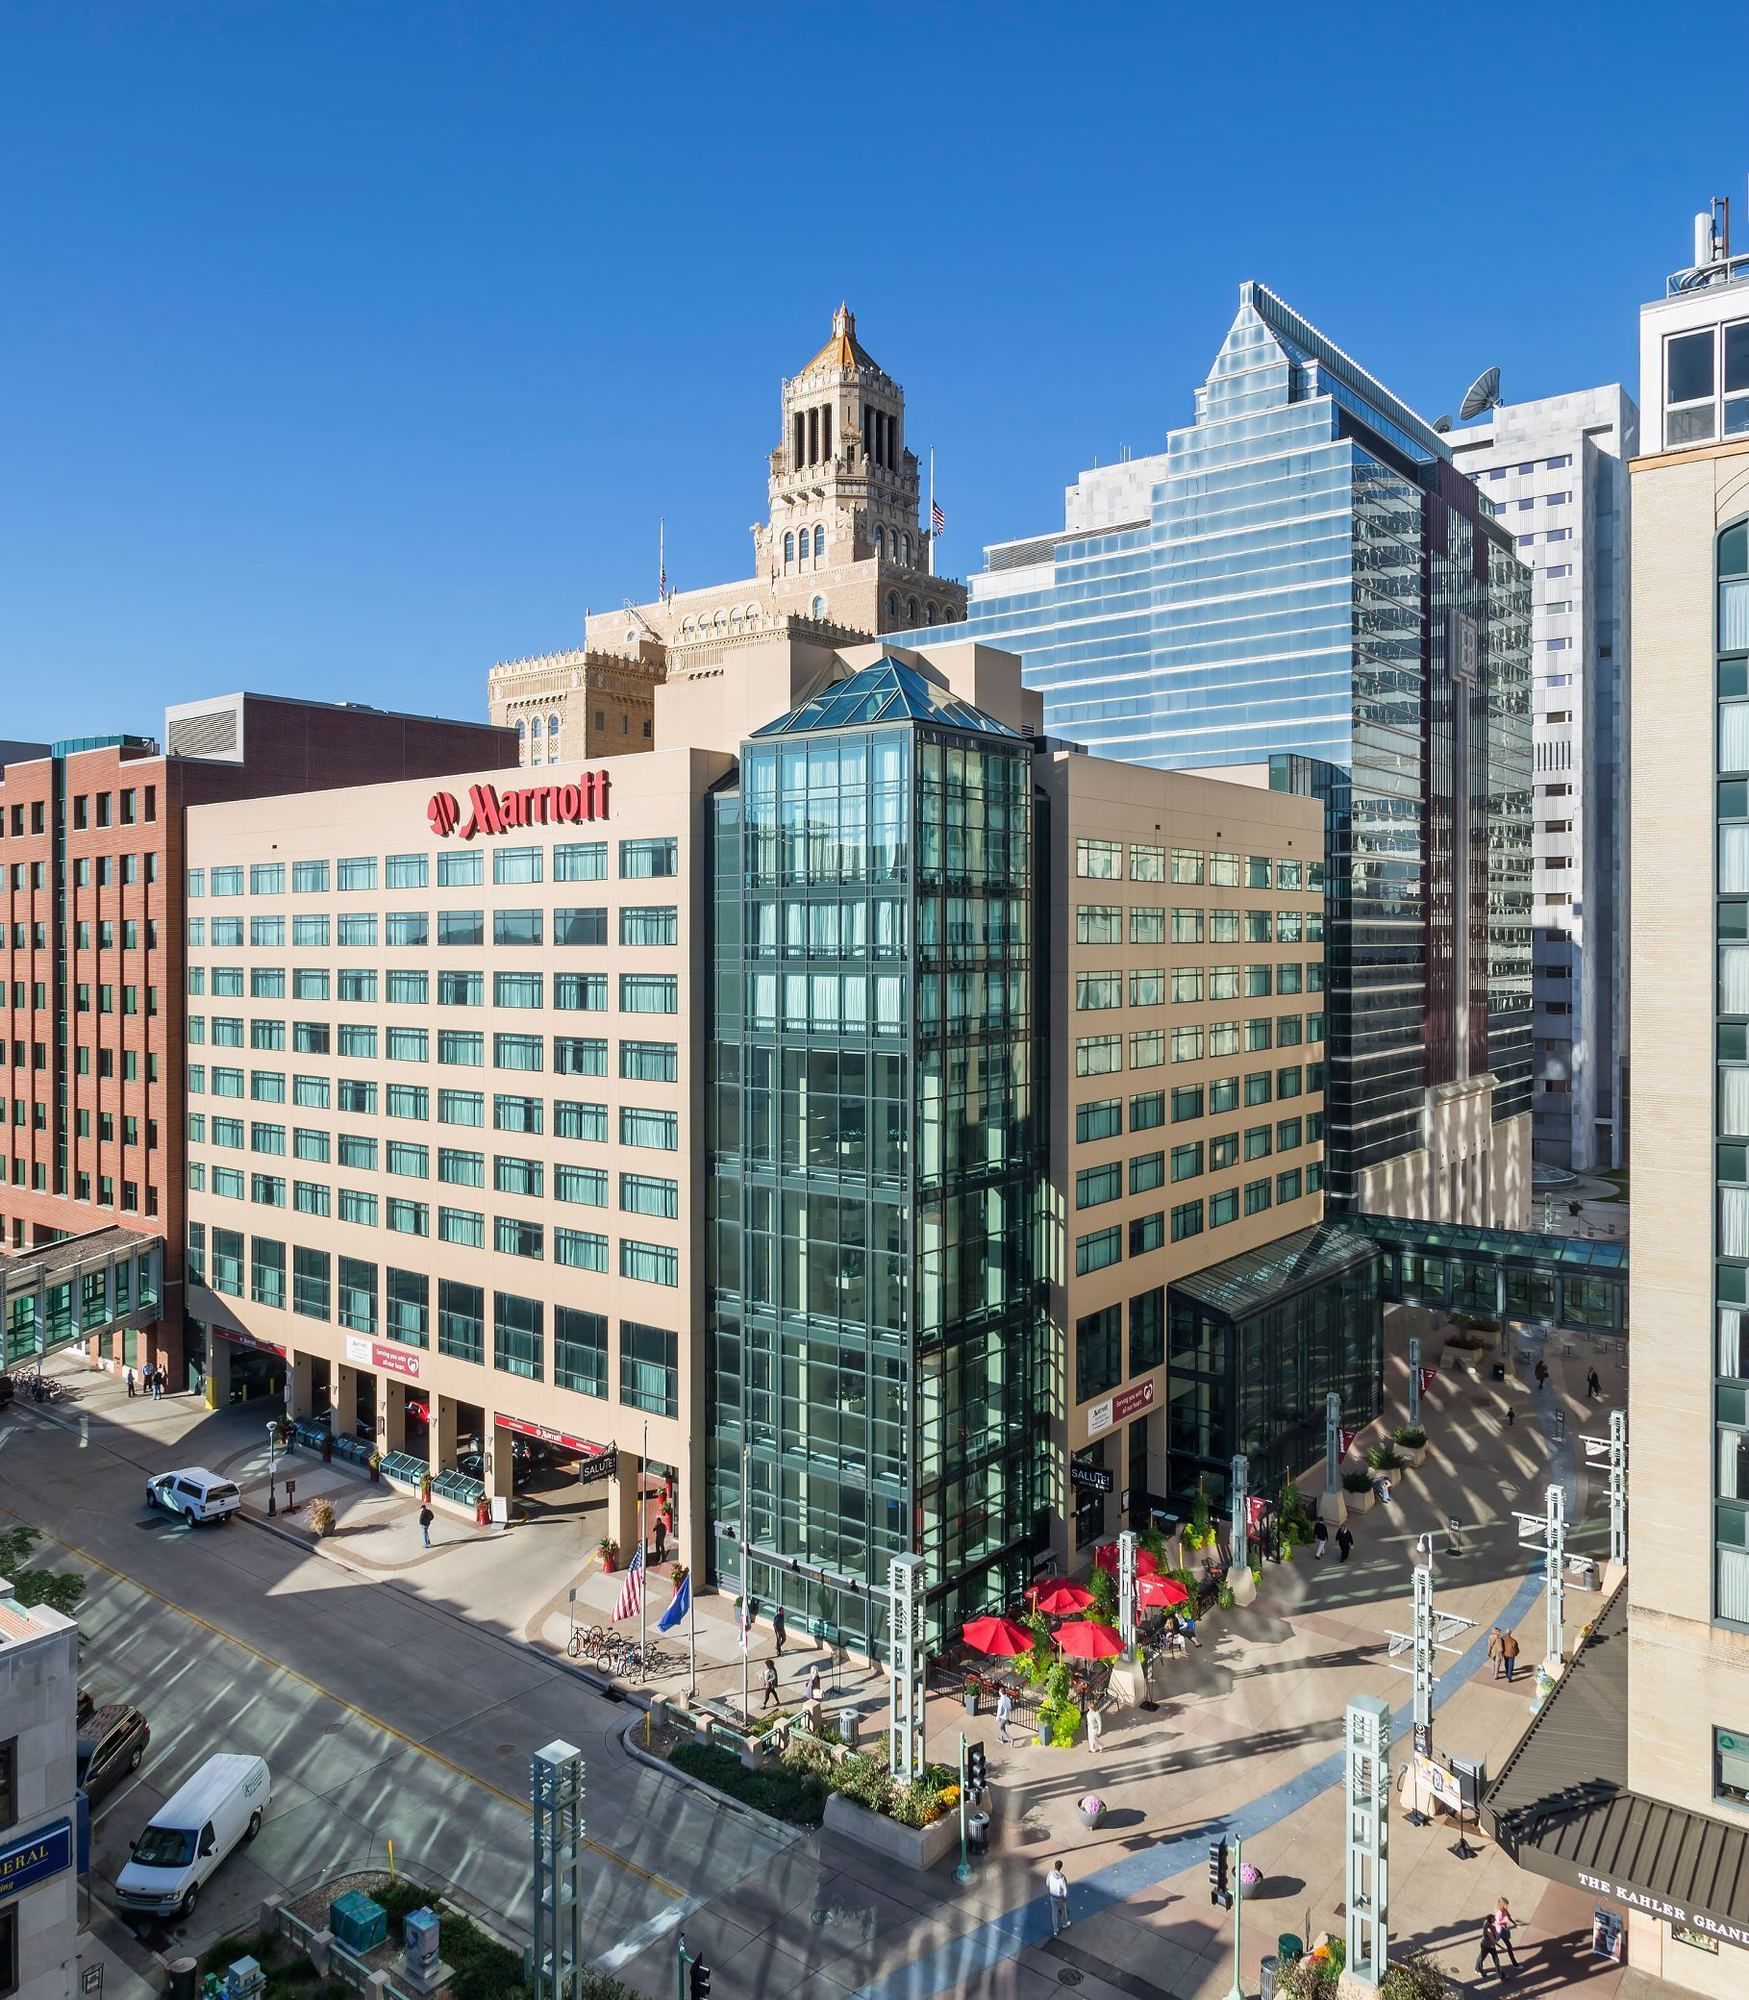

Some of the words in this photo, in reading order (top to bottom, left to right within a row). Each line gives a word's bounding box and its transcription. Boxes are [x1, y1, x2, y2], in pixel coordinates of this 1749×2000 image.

[459, 769, 612, 841] Marriott
[1071, 1468, 1110, 1486] SALUTE!
[0, 1845, 49, 1875] ERAL
[0, 1881, 14, 1892] ing
[1578, 1872, 1611, 1894] THE
[1615, 1885, 1687, 1921] KAHLER
